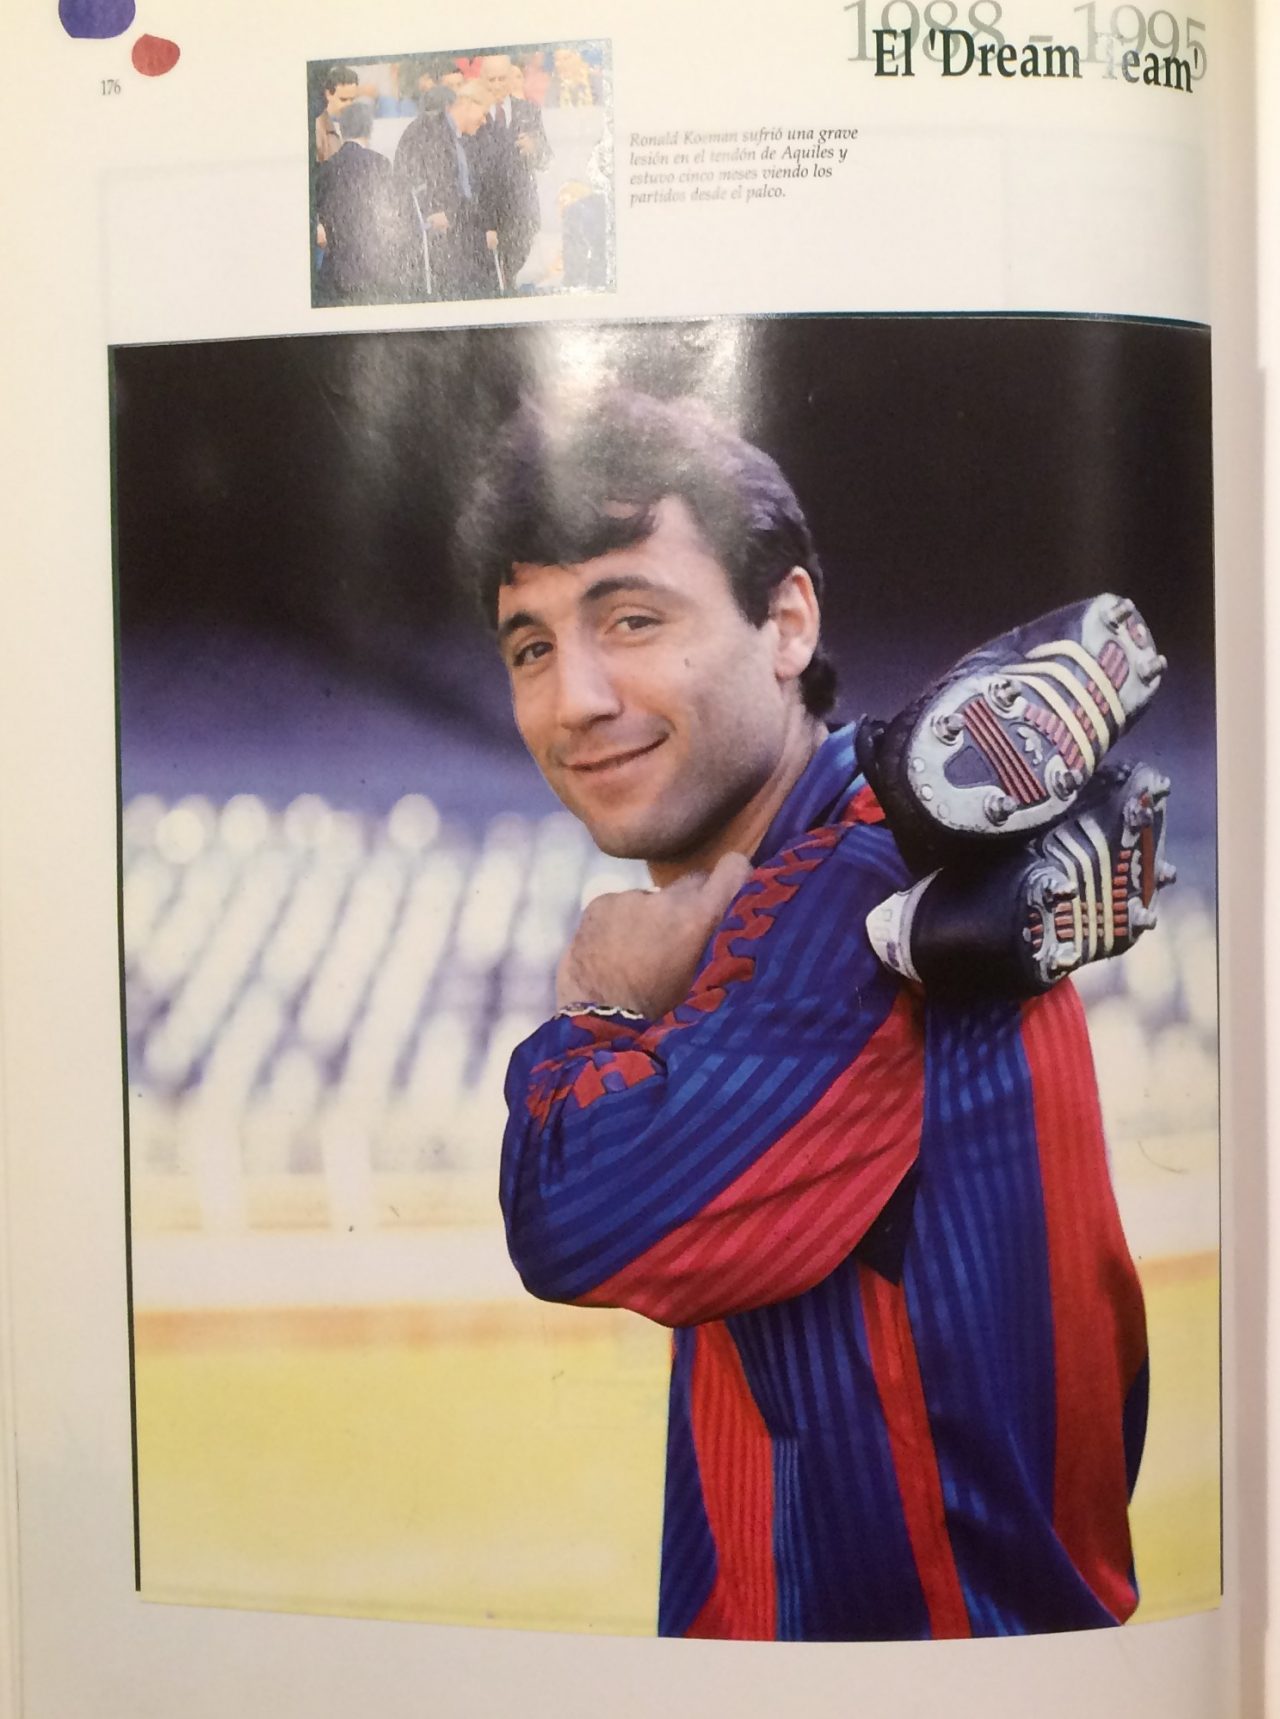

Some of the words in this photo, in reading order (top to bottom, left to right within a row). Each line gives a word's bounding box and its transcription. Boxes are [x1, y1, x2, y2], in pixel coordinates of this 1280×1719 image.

[873, 28, 915, 77] El
[929, 28, 1083, 78] 'Dream
[101, 79, 121, 96] 176
[630, 132, 679, 147] Ronald
[742, 127, 783, 145] sufrió
[787, 128, 814, 140] una
[817, 127, 859, 144] grave
[630, 150, 669, 166] lesión
[673, 152, 689, 164] en
[694, 148, 705, 164] el
[760, 145, 776, 160] de
[781, 145, 834, 163] Aquiles
[838, 147, 848, 163] y
[762, 163, 808, 180] viendo
[813, 162, 833, 178] los
[730, 184, 743, 199] el
[746, 182, 786, 203] palco.
